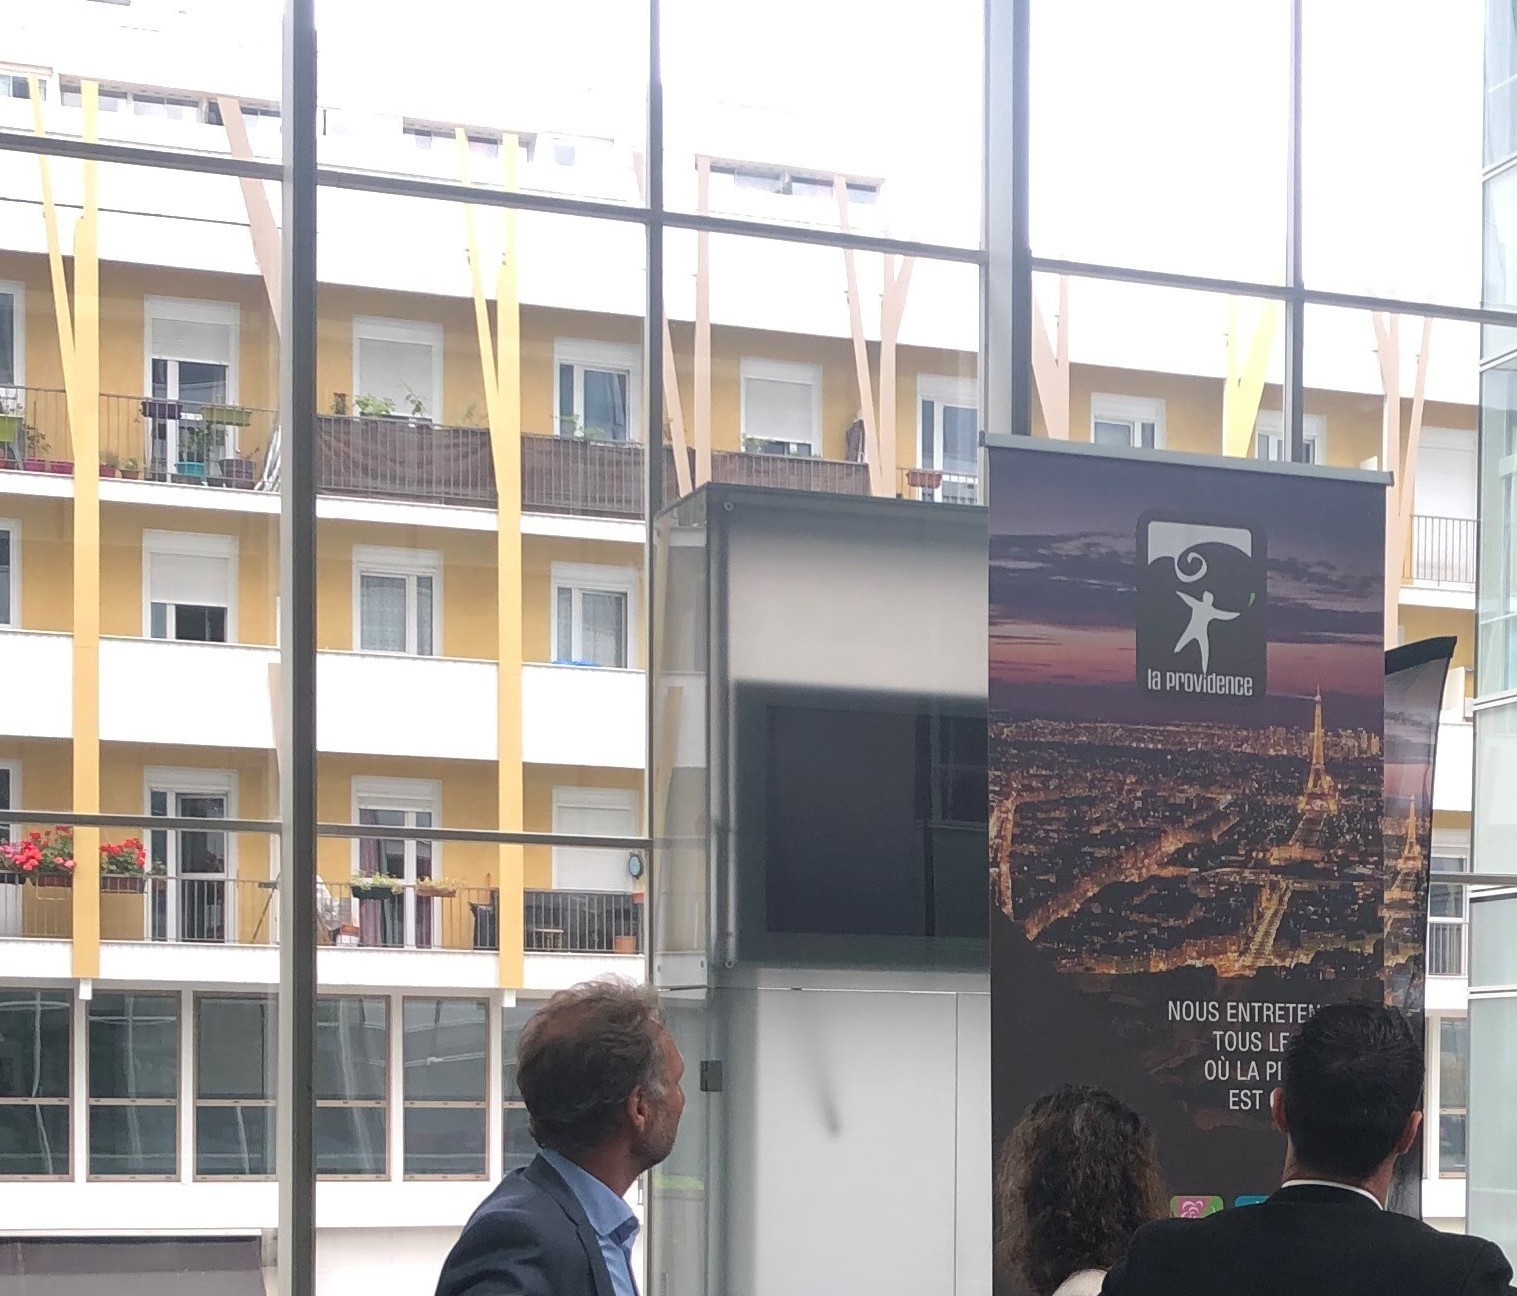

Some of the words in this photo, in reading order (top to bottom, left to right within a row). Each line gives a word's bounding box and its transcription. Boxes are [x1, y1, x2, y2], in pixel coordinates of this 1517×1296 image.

[1147, 668, 1161, 691] la
[1165, 672, 1253, 696] providence
[1168, 1000, 1220, 1022] NOUS
[1212, 1031, 1262, 1052] TOUS
[1204, 1056, 1230, 1081] OÙ
[1237, 1060, 1260, 1081] LA
[1229, 1089, 1263, 1110] EST
